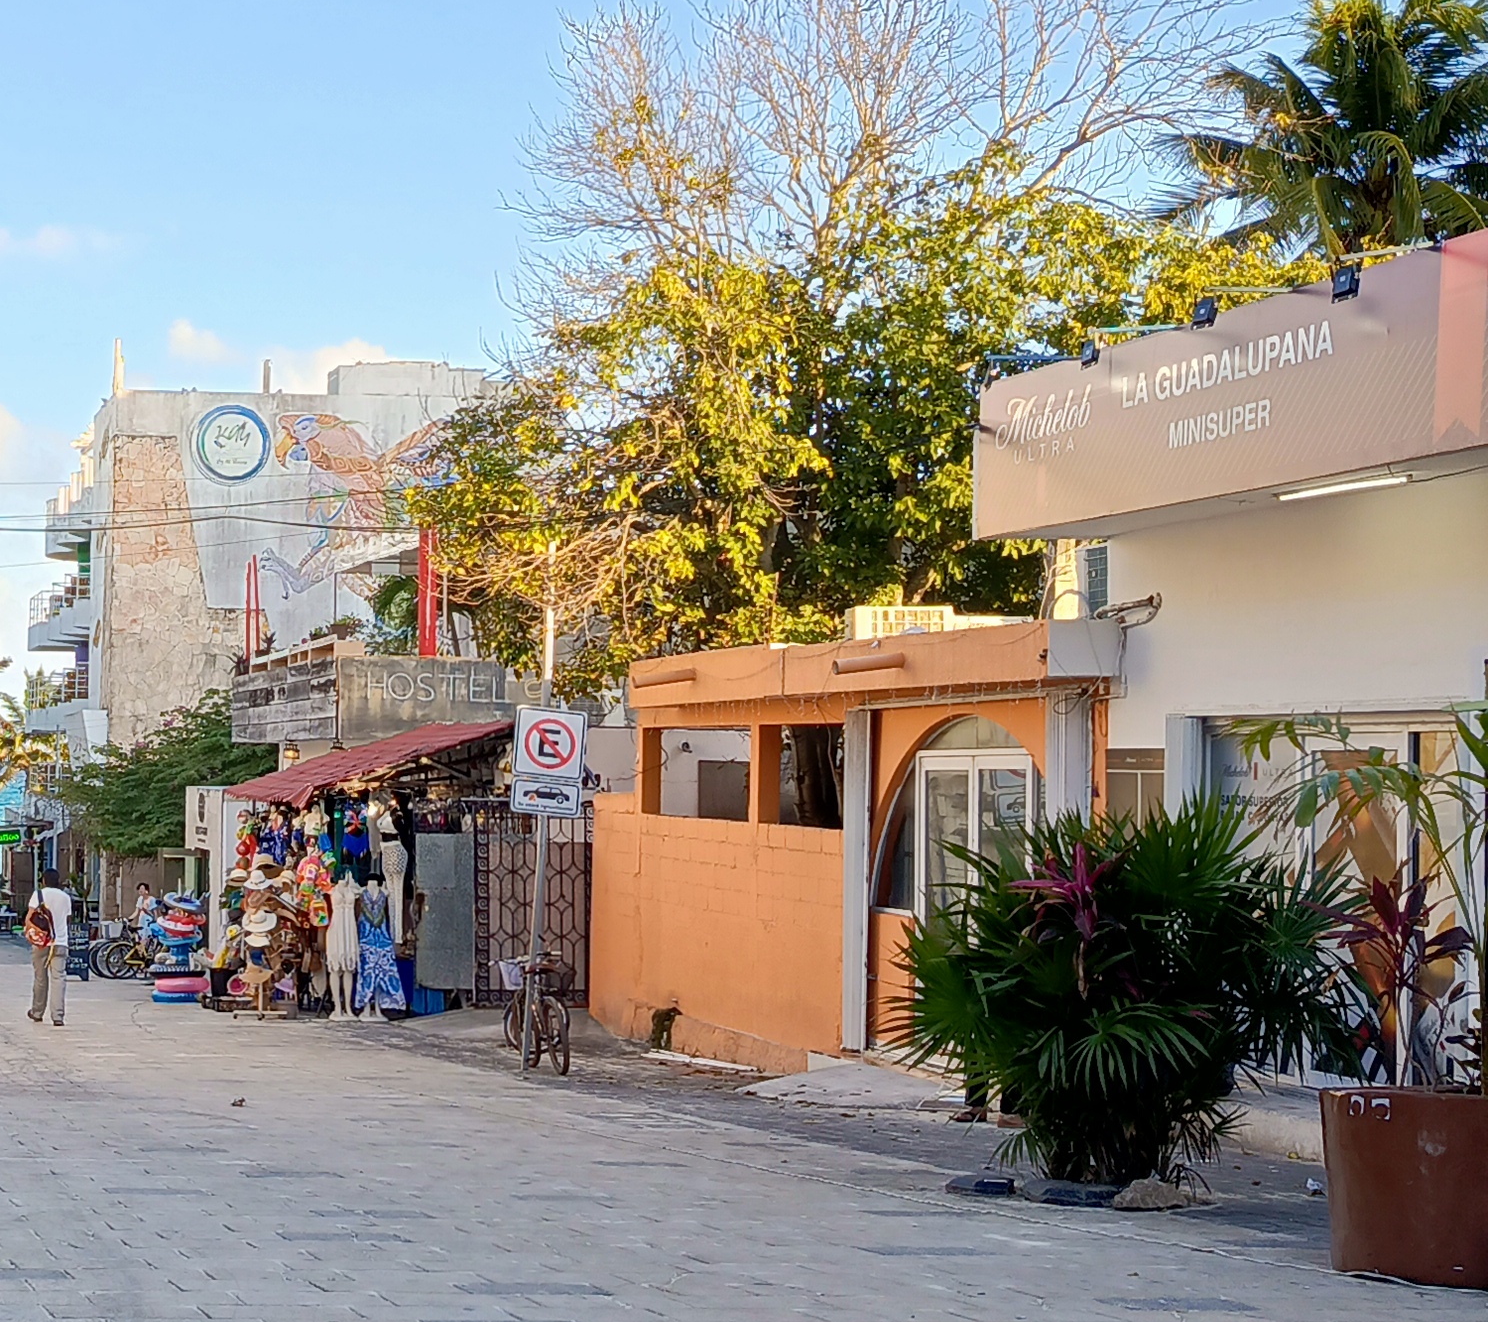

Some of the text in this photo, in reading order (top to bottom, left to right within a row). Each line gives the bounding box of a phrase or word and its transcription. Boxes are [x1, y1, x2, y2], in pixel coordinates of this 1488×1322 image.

[1121, 321, 1333, 408] LA GUADALUPANA
[996, 383, 1092, 449] Michelob
[1168, 398, 1271, 450] MINISUPER
[1013, 436, 1075, 465] ULTRA
[367, 669, 509, 703] HOSTEL
